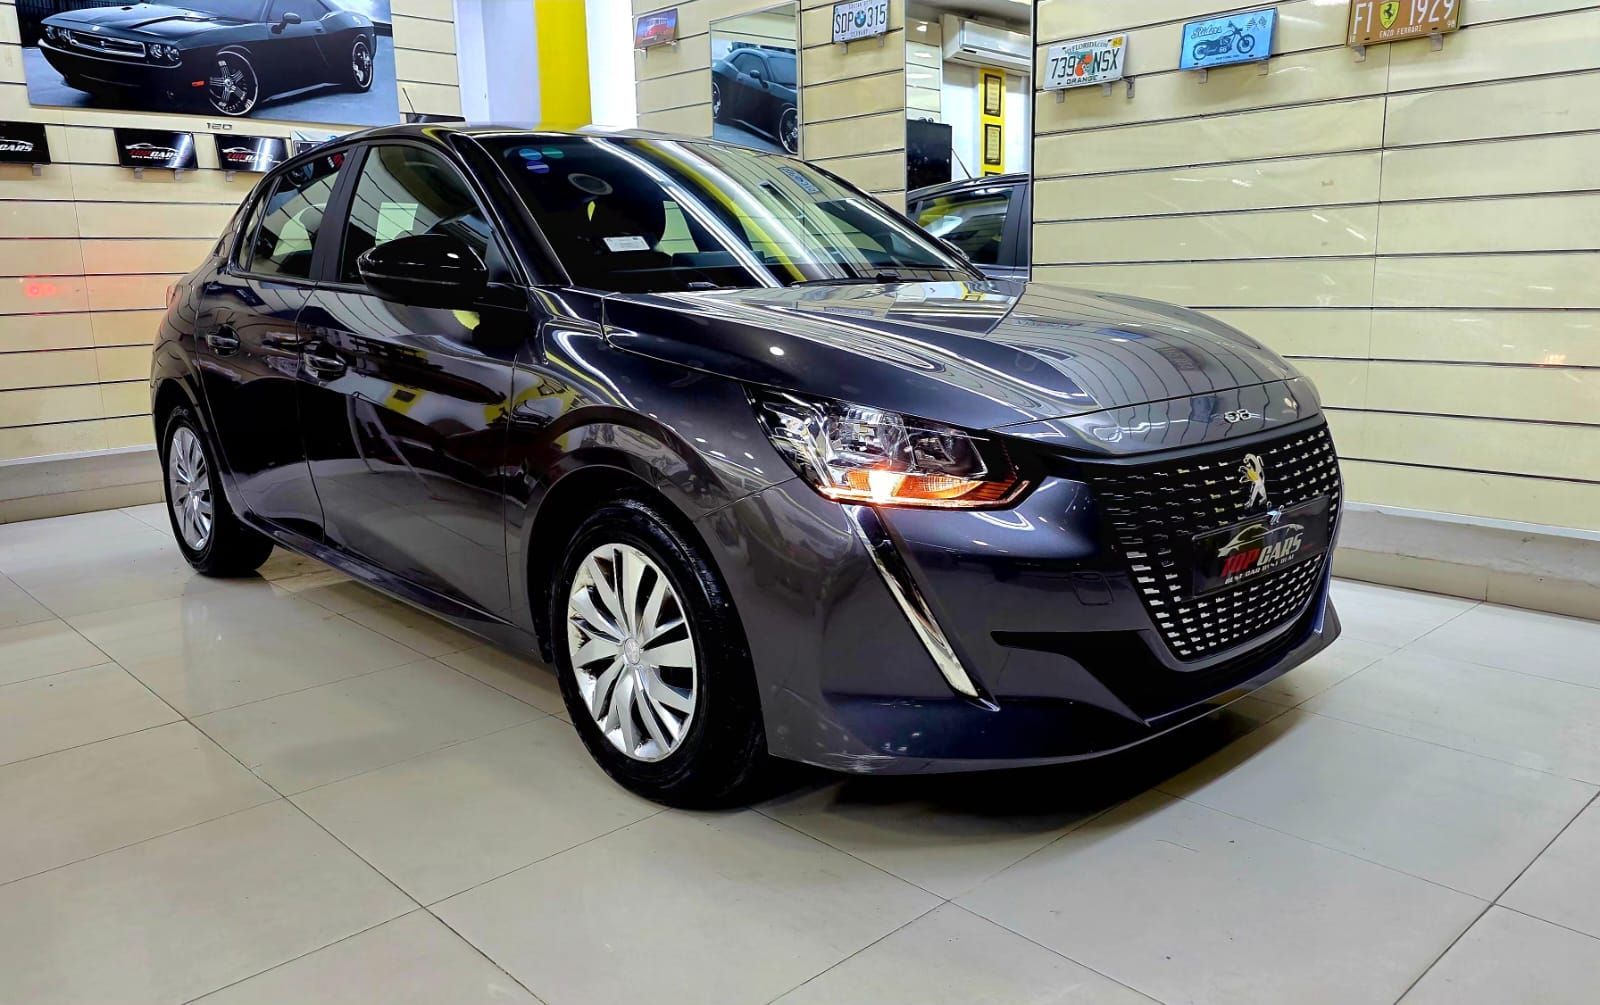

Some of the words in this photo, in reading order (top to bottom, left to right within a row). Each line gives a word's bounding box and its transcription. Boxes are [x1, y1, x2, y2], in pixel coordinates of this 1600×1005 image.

[867, 4, 886, 28] 315
[1353, 2, 1373, 34] F1
[1409, 0, 1454, 26] 1929
[1051, 55, 1076, 79] 739
[1091, 48, 1120, 74] NSX
[1066, 75, 1098, 85] ORANGE
